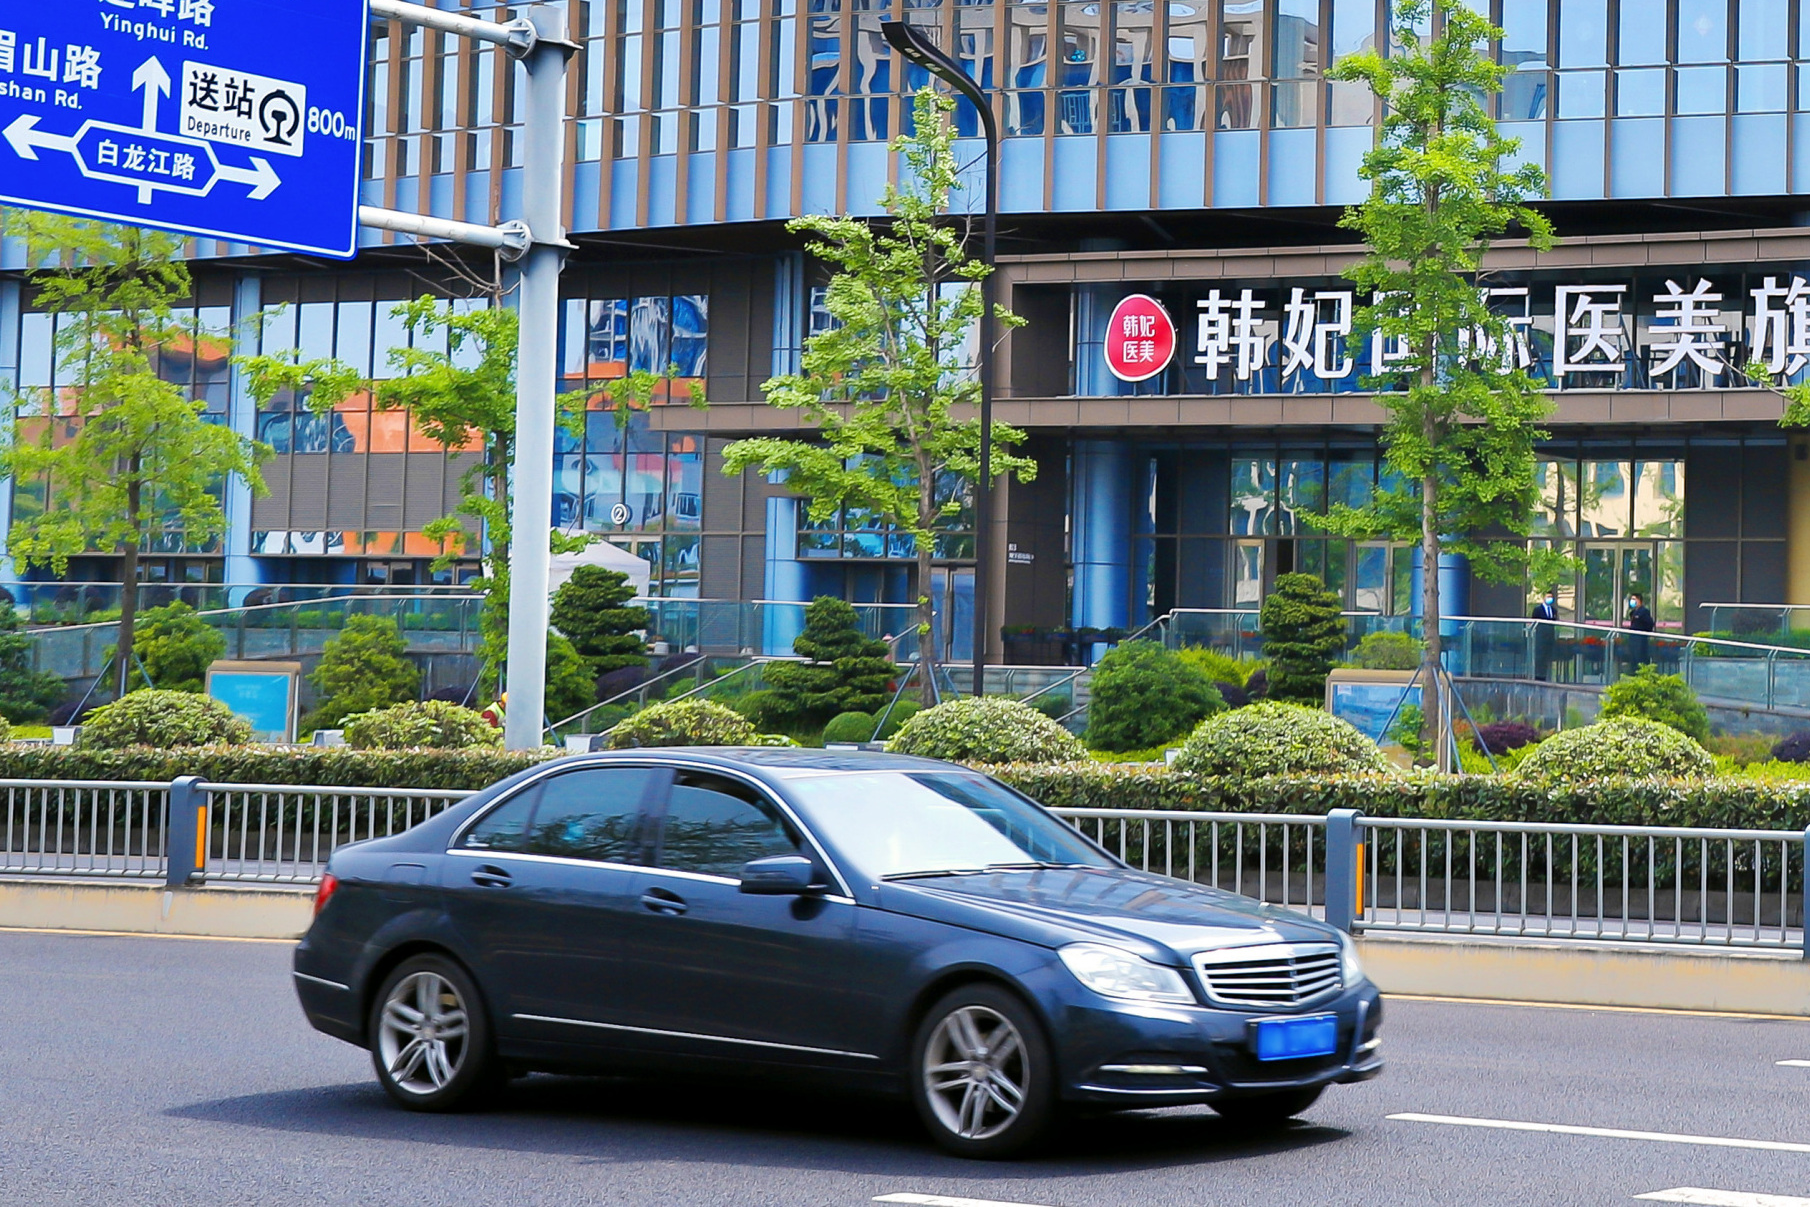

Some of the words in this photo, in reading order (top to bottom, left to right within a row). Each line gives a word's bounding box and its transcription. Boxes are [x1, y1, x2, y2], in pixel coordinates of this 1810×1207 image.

[101, 12, 176, 44] Yinghui
[183, 30, 209, 51] Rd.
[55, 89, 83, 110] Rd.
[188, 69, 256, 120] 送站
[187, 115, 252, 142] Departure
[307, 106, 356, 141] 800m
[97, 138, 197, 181] 白龙江路
[1122, 314, 1156, 337] 韩妃
[1122, 340, 1155, 363] 医美
